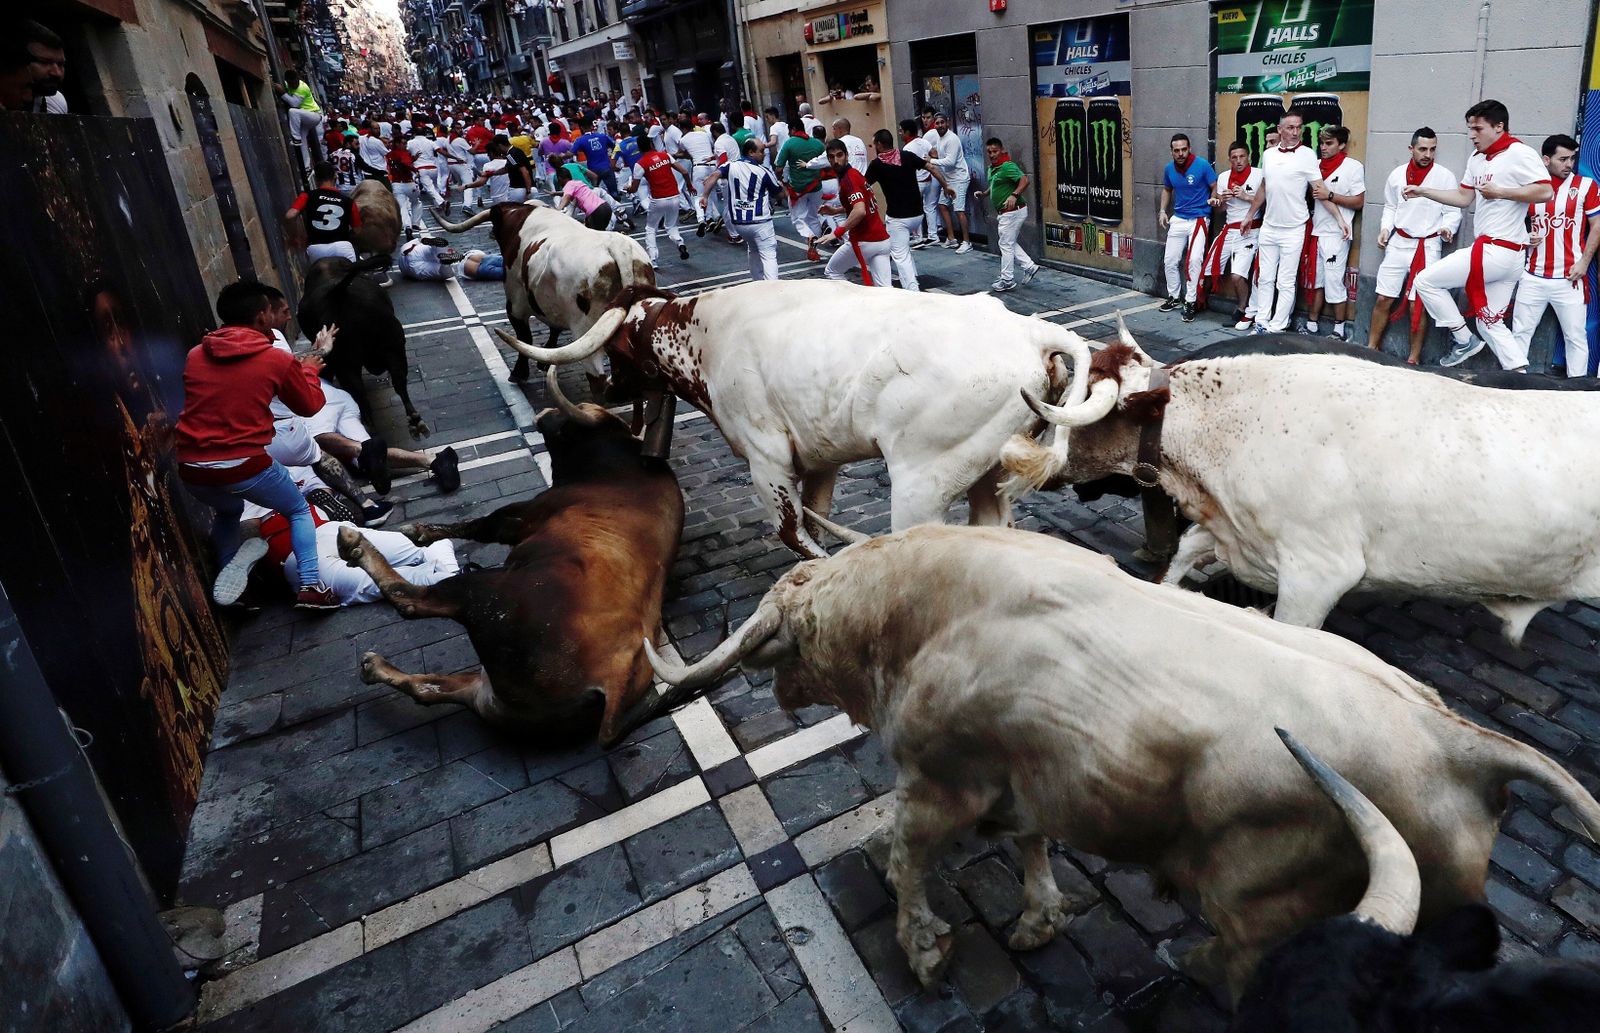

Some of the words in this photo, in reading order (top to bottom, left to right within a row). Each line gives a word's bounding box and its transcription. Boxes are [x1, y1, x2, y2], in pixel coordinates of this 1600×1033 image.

[1222, 11, 1238, 20] NUEVO
[1263, 24, 1320, 48] HALLS
[1066, 45, 1099, 61] HALLS
[1262, 52, 1307, 65] CHICLES
[1064, 65, 1092, 76] CHICLES
[1288, 70, 1315, 87] HALLS
[1081, 81, 1098, 93] HALLS
[1058, 182, 1087, 195] MONSTER
[1090, 186, 1122, 199] MONSTER
[311, 203, 345, 231] 3
